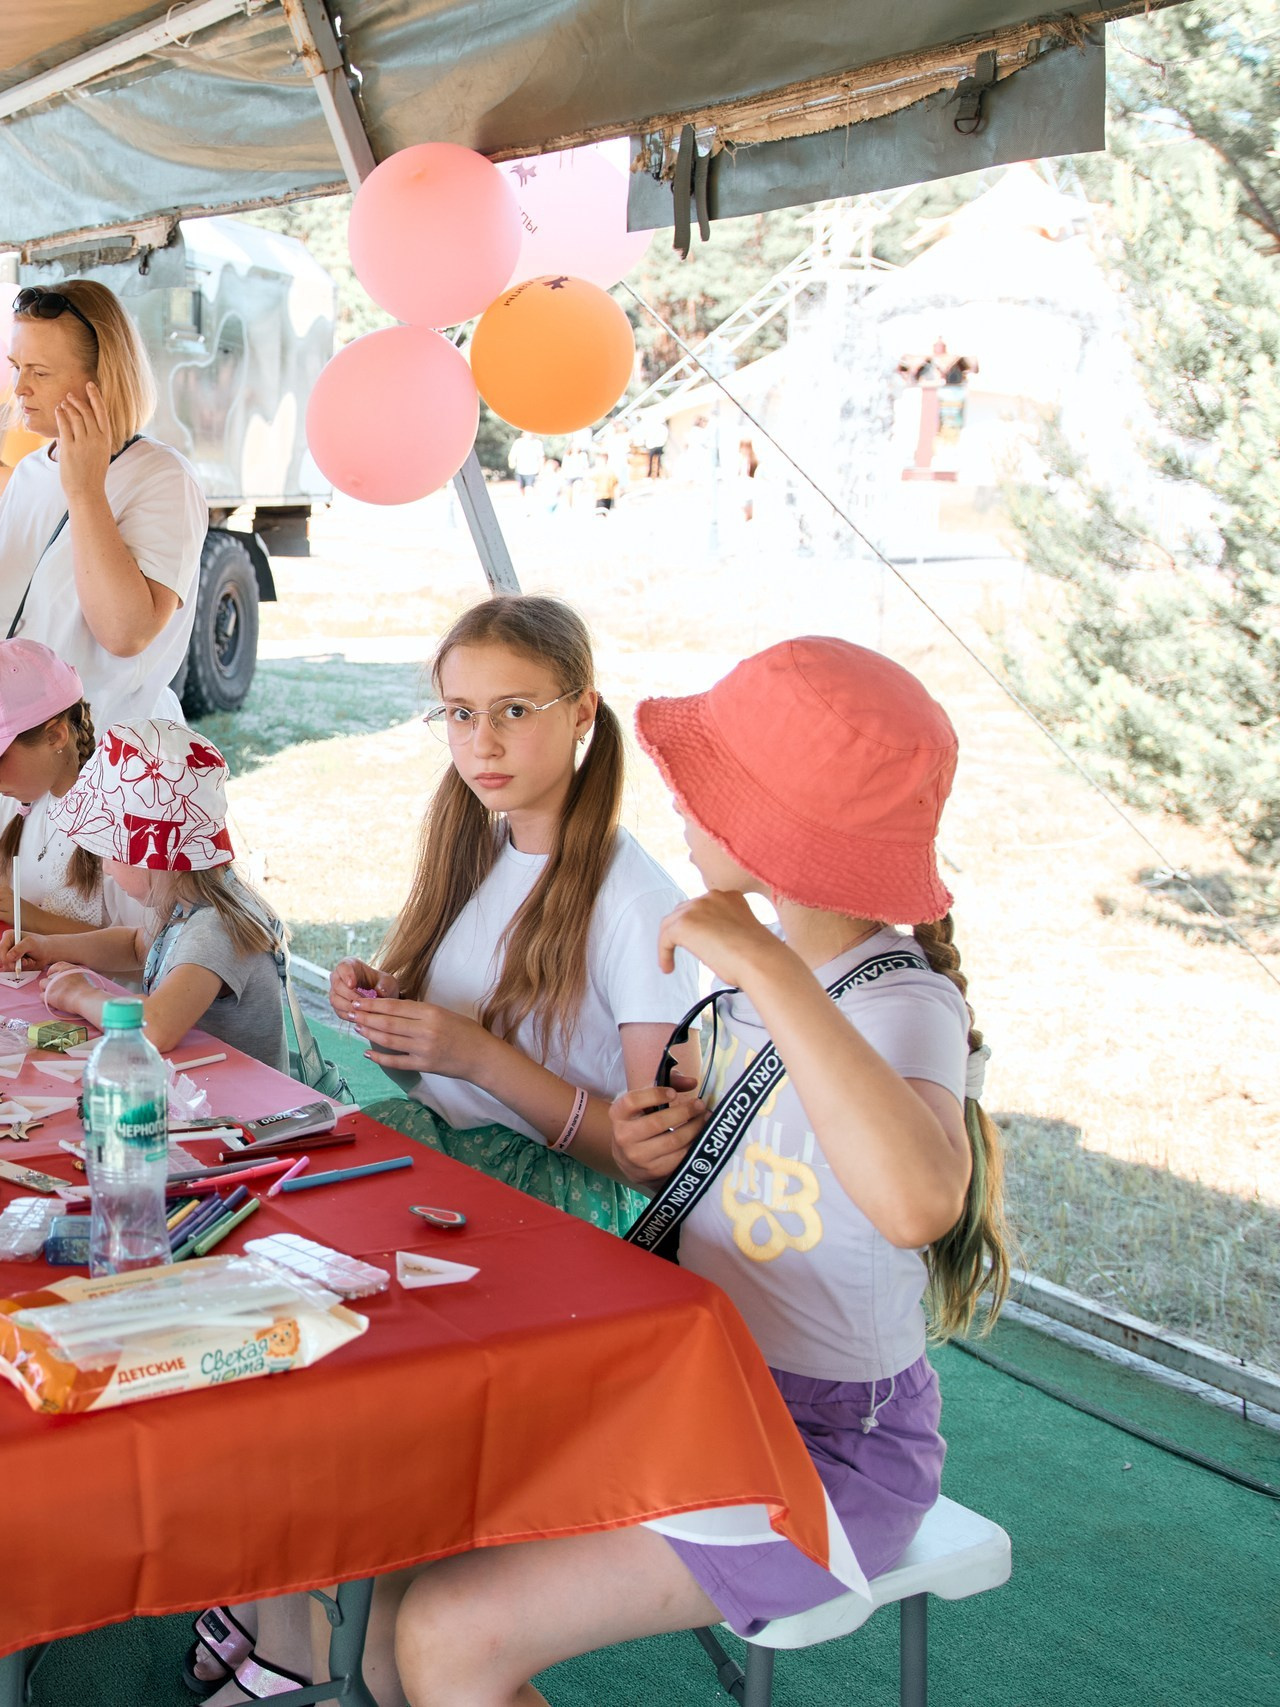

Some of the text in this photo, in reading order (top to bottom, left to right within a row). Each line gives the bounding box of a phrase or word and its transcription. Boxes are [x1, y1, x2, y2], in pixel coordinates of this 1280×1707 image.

[117, 1118, 165, 1138] ЧЕРНОГ
[704, 1092, 752, 1158] CHAMPS
[668, 1173, 701, 1208] BORN
[637, 1202, 677, 1246] CHAMPS
[118, 1356, 187, 1385] ДЕТСКИЕ
[201, 1339, 268, 1374] Свежая
